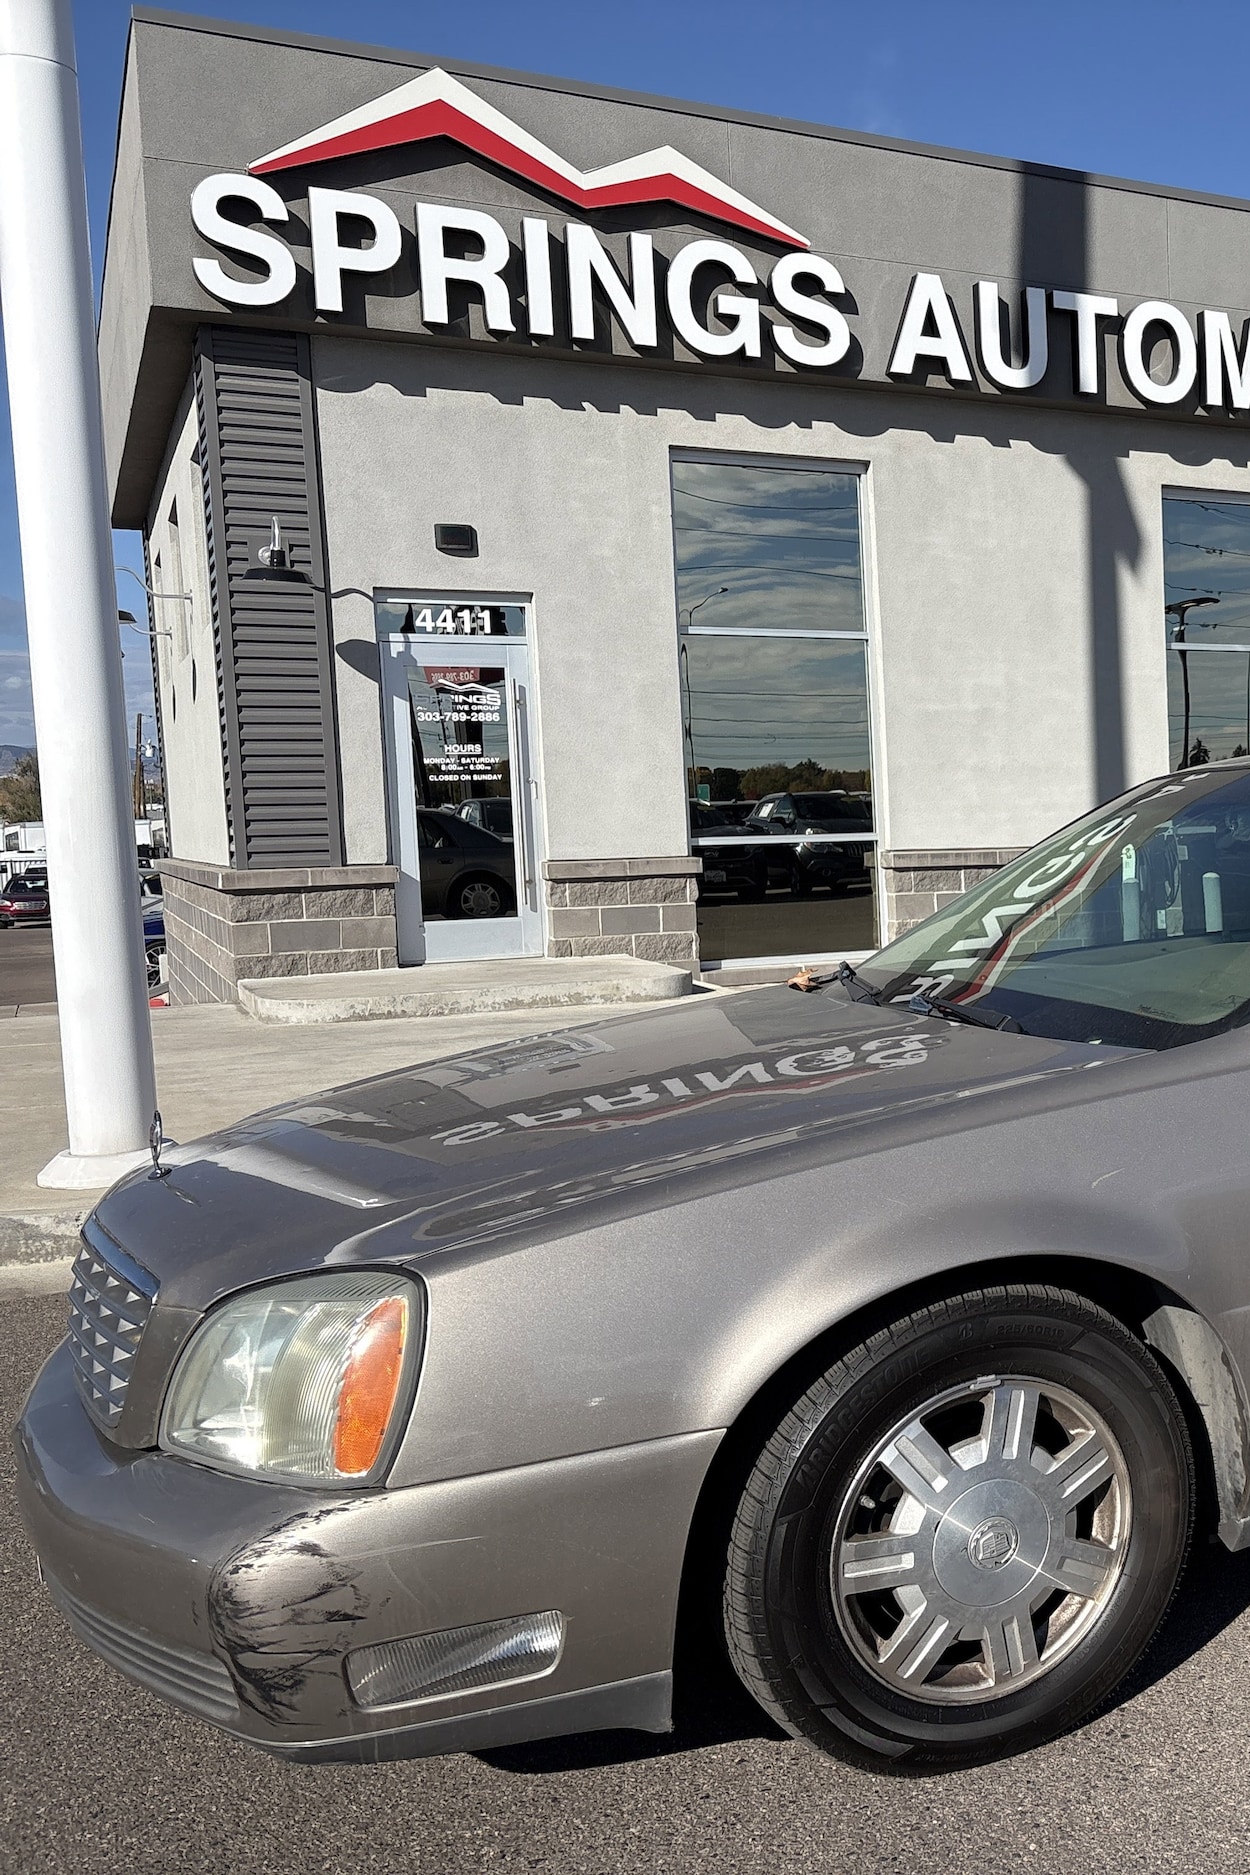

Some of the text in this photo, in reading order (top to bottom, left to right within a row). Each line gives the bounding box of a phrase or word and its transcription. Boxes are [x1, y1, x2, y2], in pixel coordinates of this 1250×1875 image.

[188, 172, 852, 368] SPRINGS
[415, 608, 492, 634] 4411
[417, 711, 500, 722] 303-789-2886
[444, 743, 482, 754] HOURS
[423, 757, 456, 765] MONDAY
[429, 774, 460, 782] CLOSED
[795, 1346, 931, 1489] BRIDGESTONE
